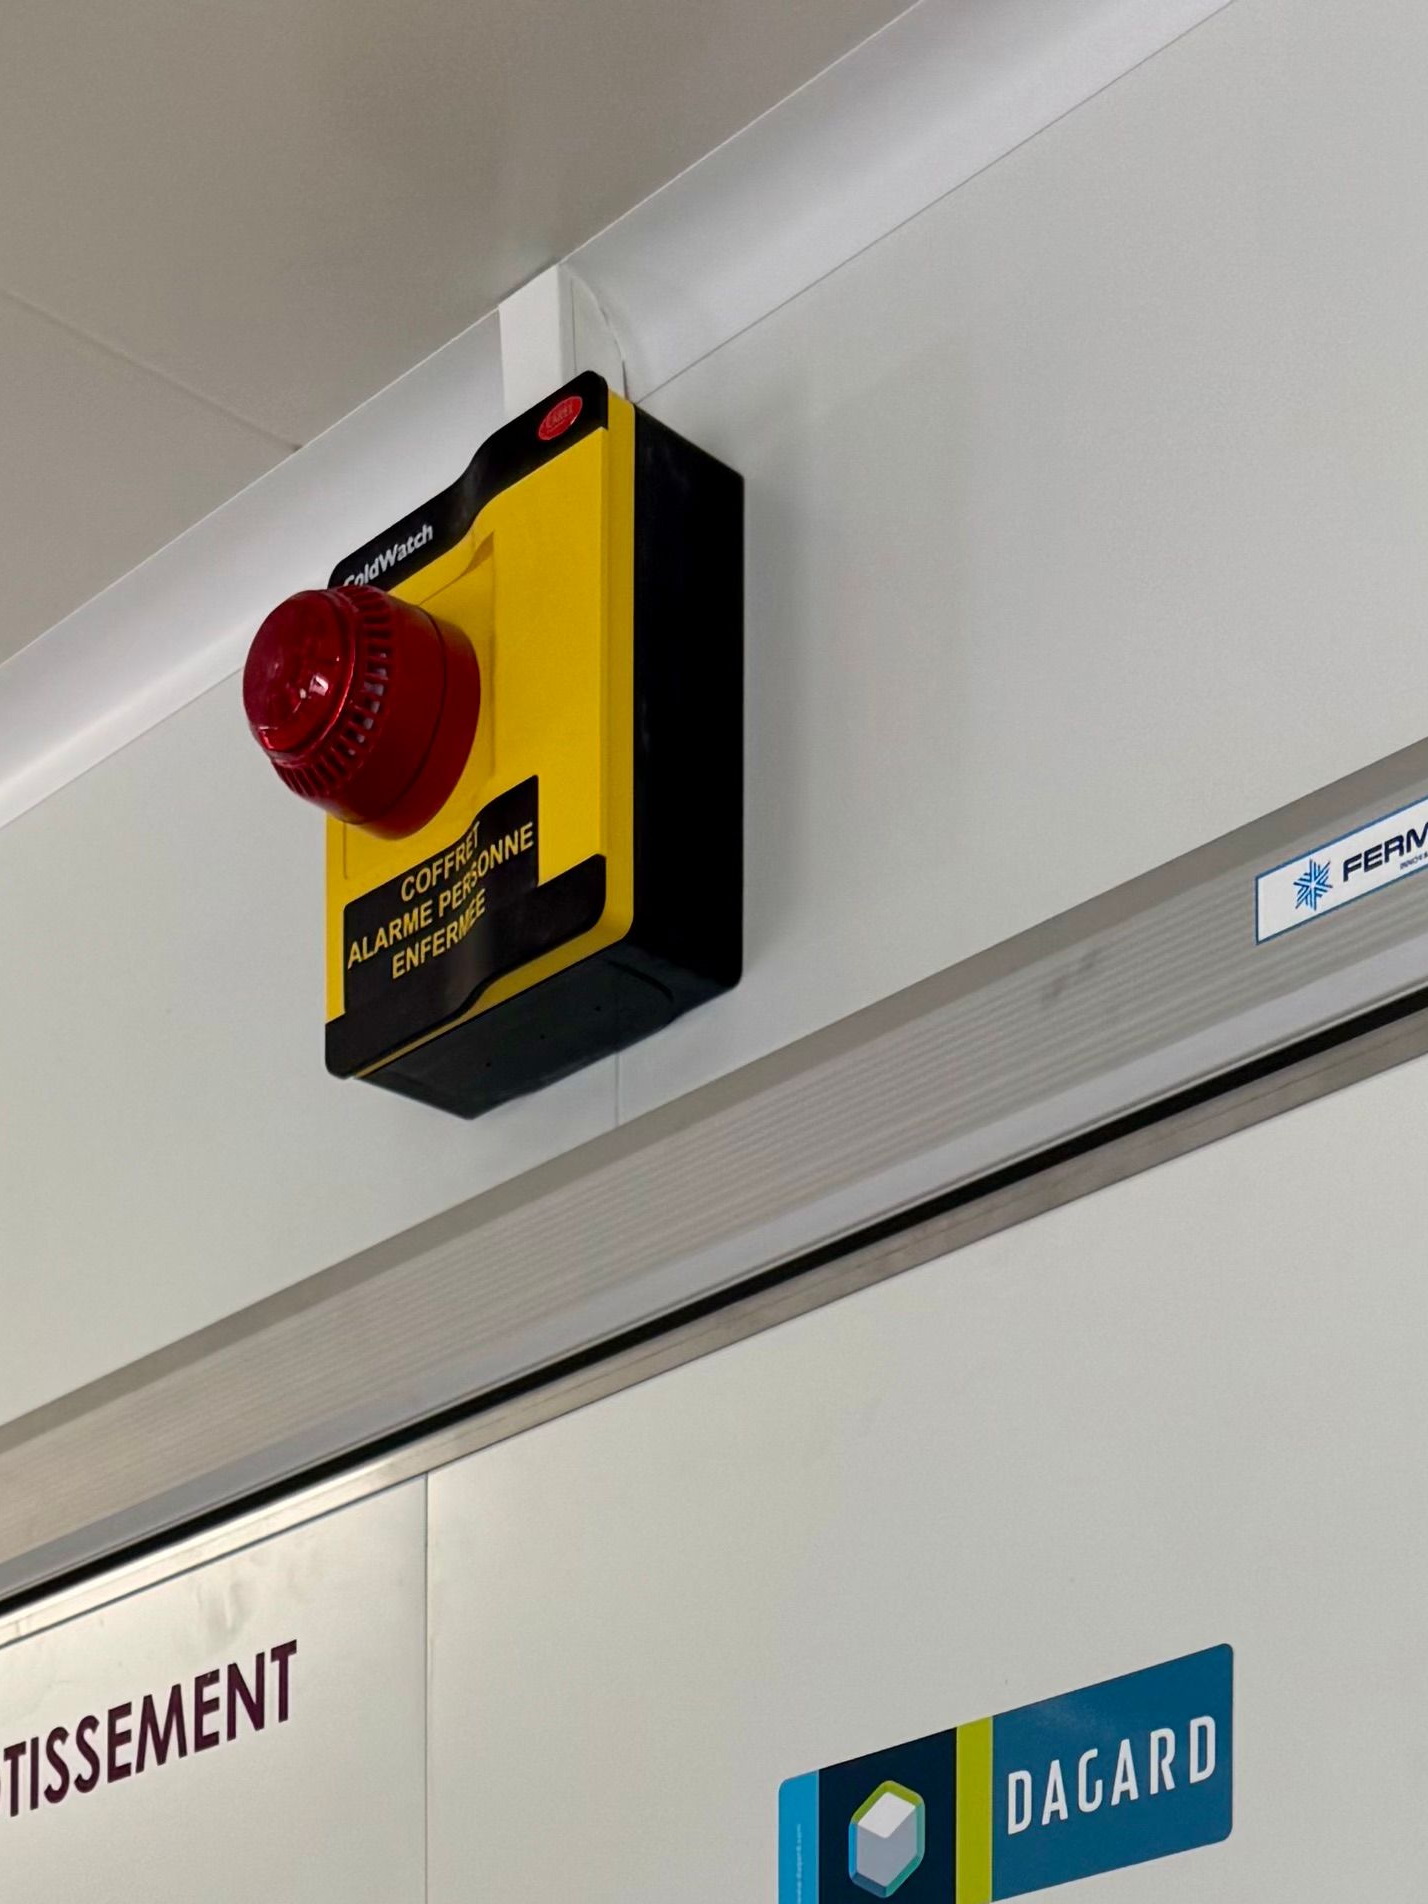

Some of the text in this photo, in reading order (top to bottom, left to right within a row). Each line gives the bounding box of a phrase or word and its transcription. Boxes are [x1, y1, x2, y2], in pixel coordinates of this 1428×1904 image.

[348, 822, 534, 969] ALARME PERSONNE
[401, 821, 480, 901] COFFRET
[1007, 1715, 1217, 1836] DAGARD
